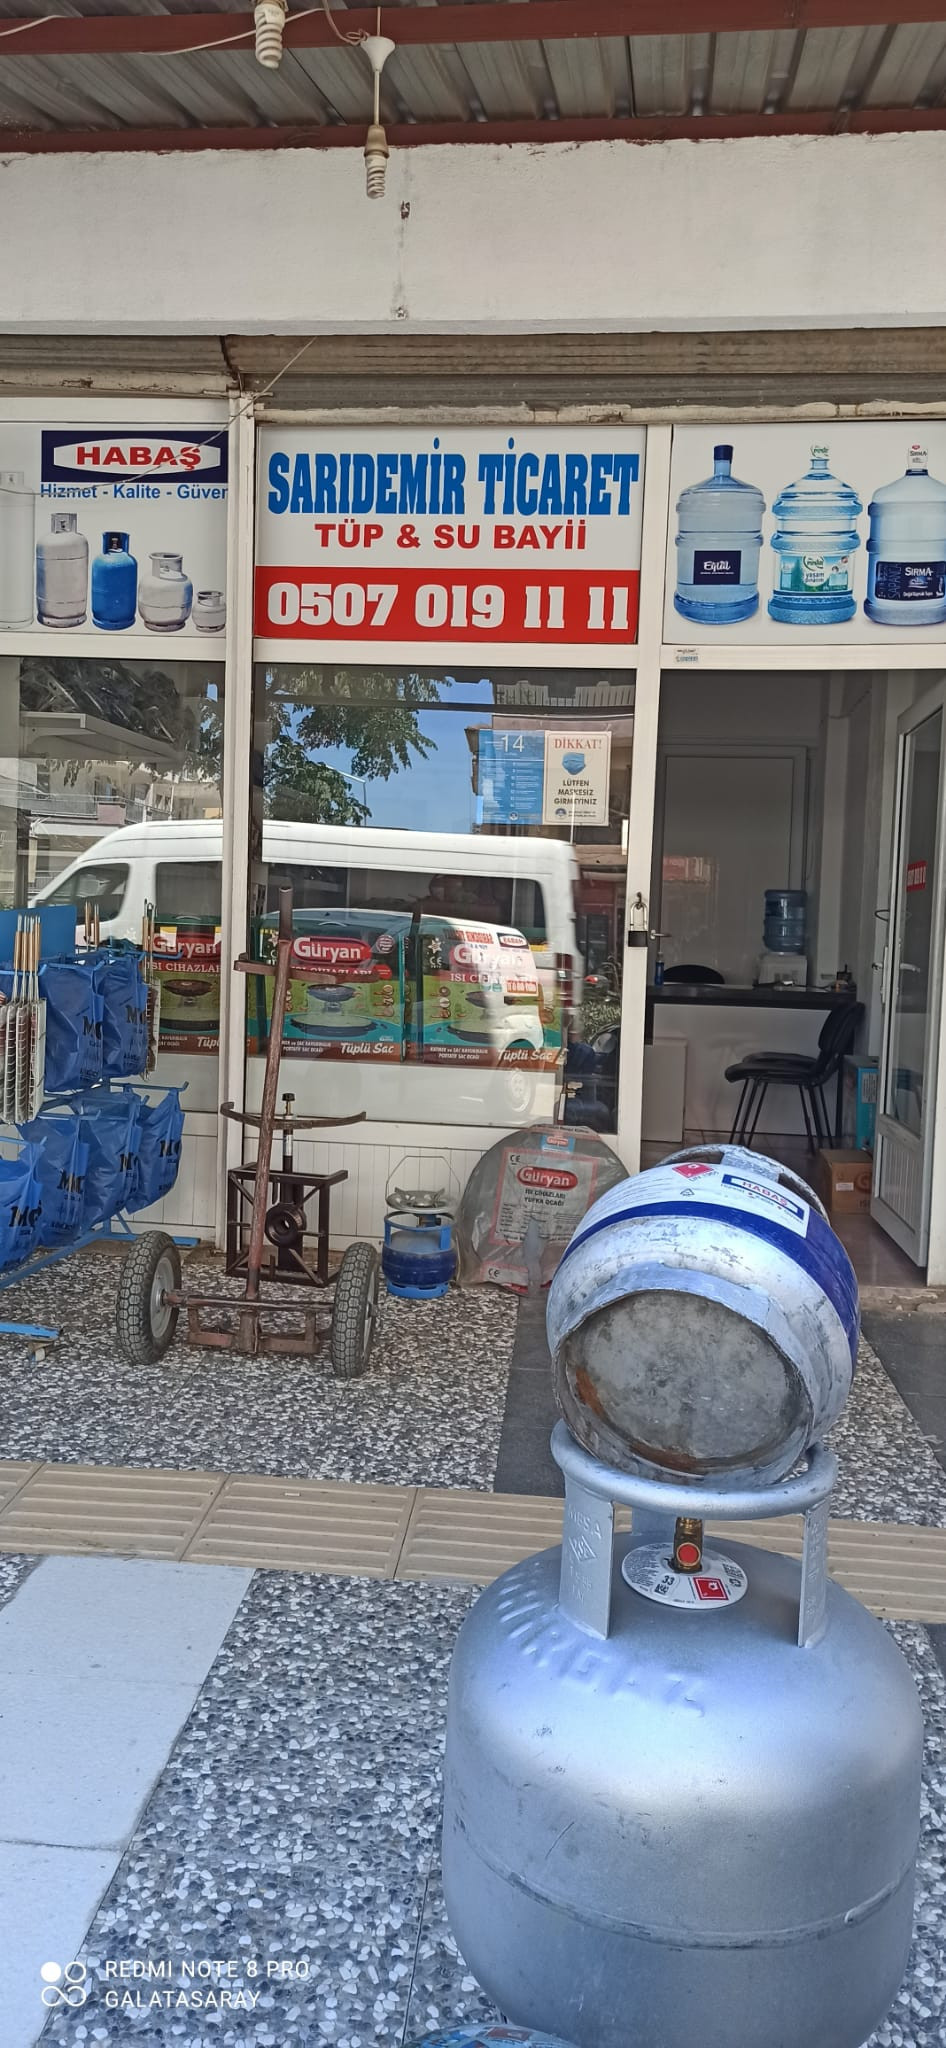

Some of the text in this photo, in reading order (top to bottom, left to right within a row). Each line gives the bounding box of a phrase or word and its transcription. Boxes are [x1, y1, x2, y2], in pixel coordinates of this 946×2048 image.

[76, 446, 202, 472] HABAŞ
[268, 437, 639, 516] SARIDEMİR TİCARET
[41, 484, 97, 499] Hizmet
[113, 484, 161, 499] Kalite
[315, 519, 587, 549] TÜP & SU BAYİİ
[905, 566, 933, 576] SIRMA
[268, 583, 630, 630] 0507 019 11 11
[501, 734, 524, 753] 14
[554, 737, 602, 750] DİKKAT!
[562, 778, 590, 786] LÜTFEN
[293, 936, 362, 964] Güryan
[196, 1036, 220, 1049] Tüp
[340, 1042, 394, 1056] Tüplü Sac
[520, 1167, 570, 1188] Güryan
